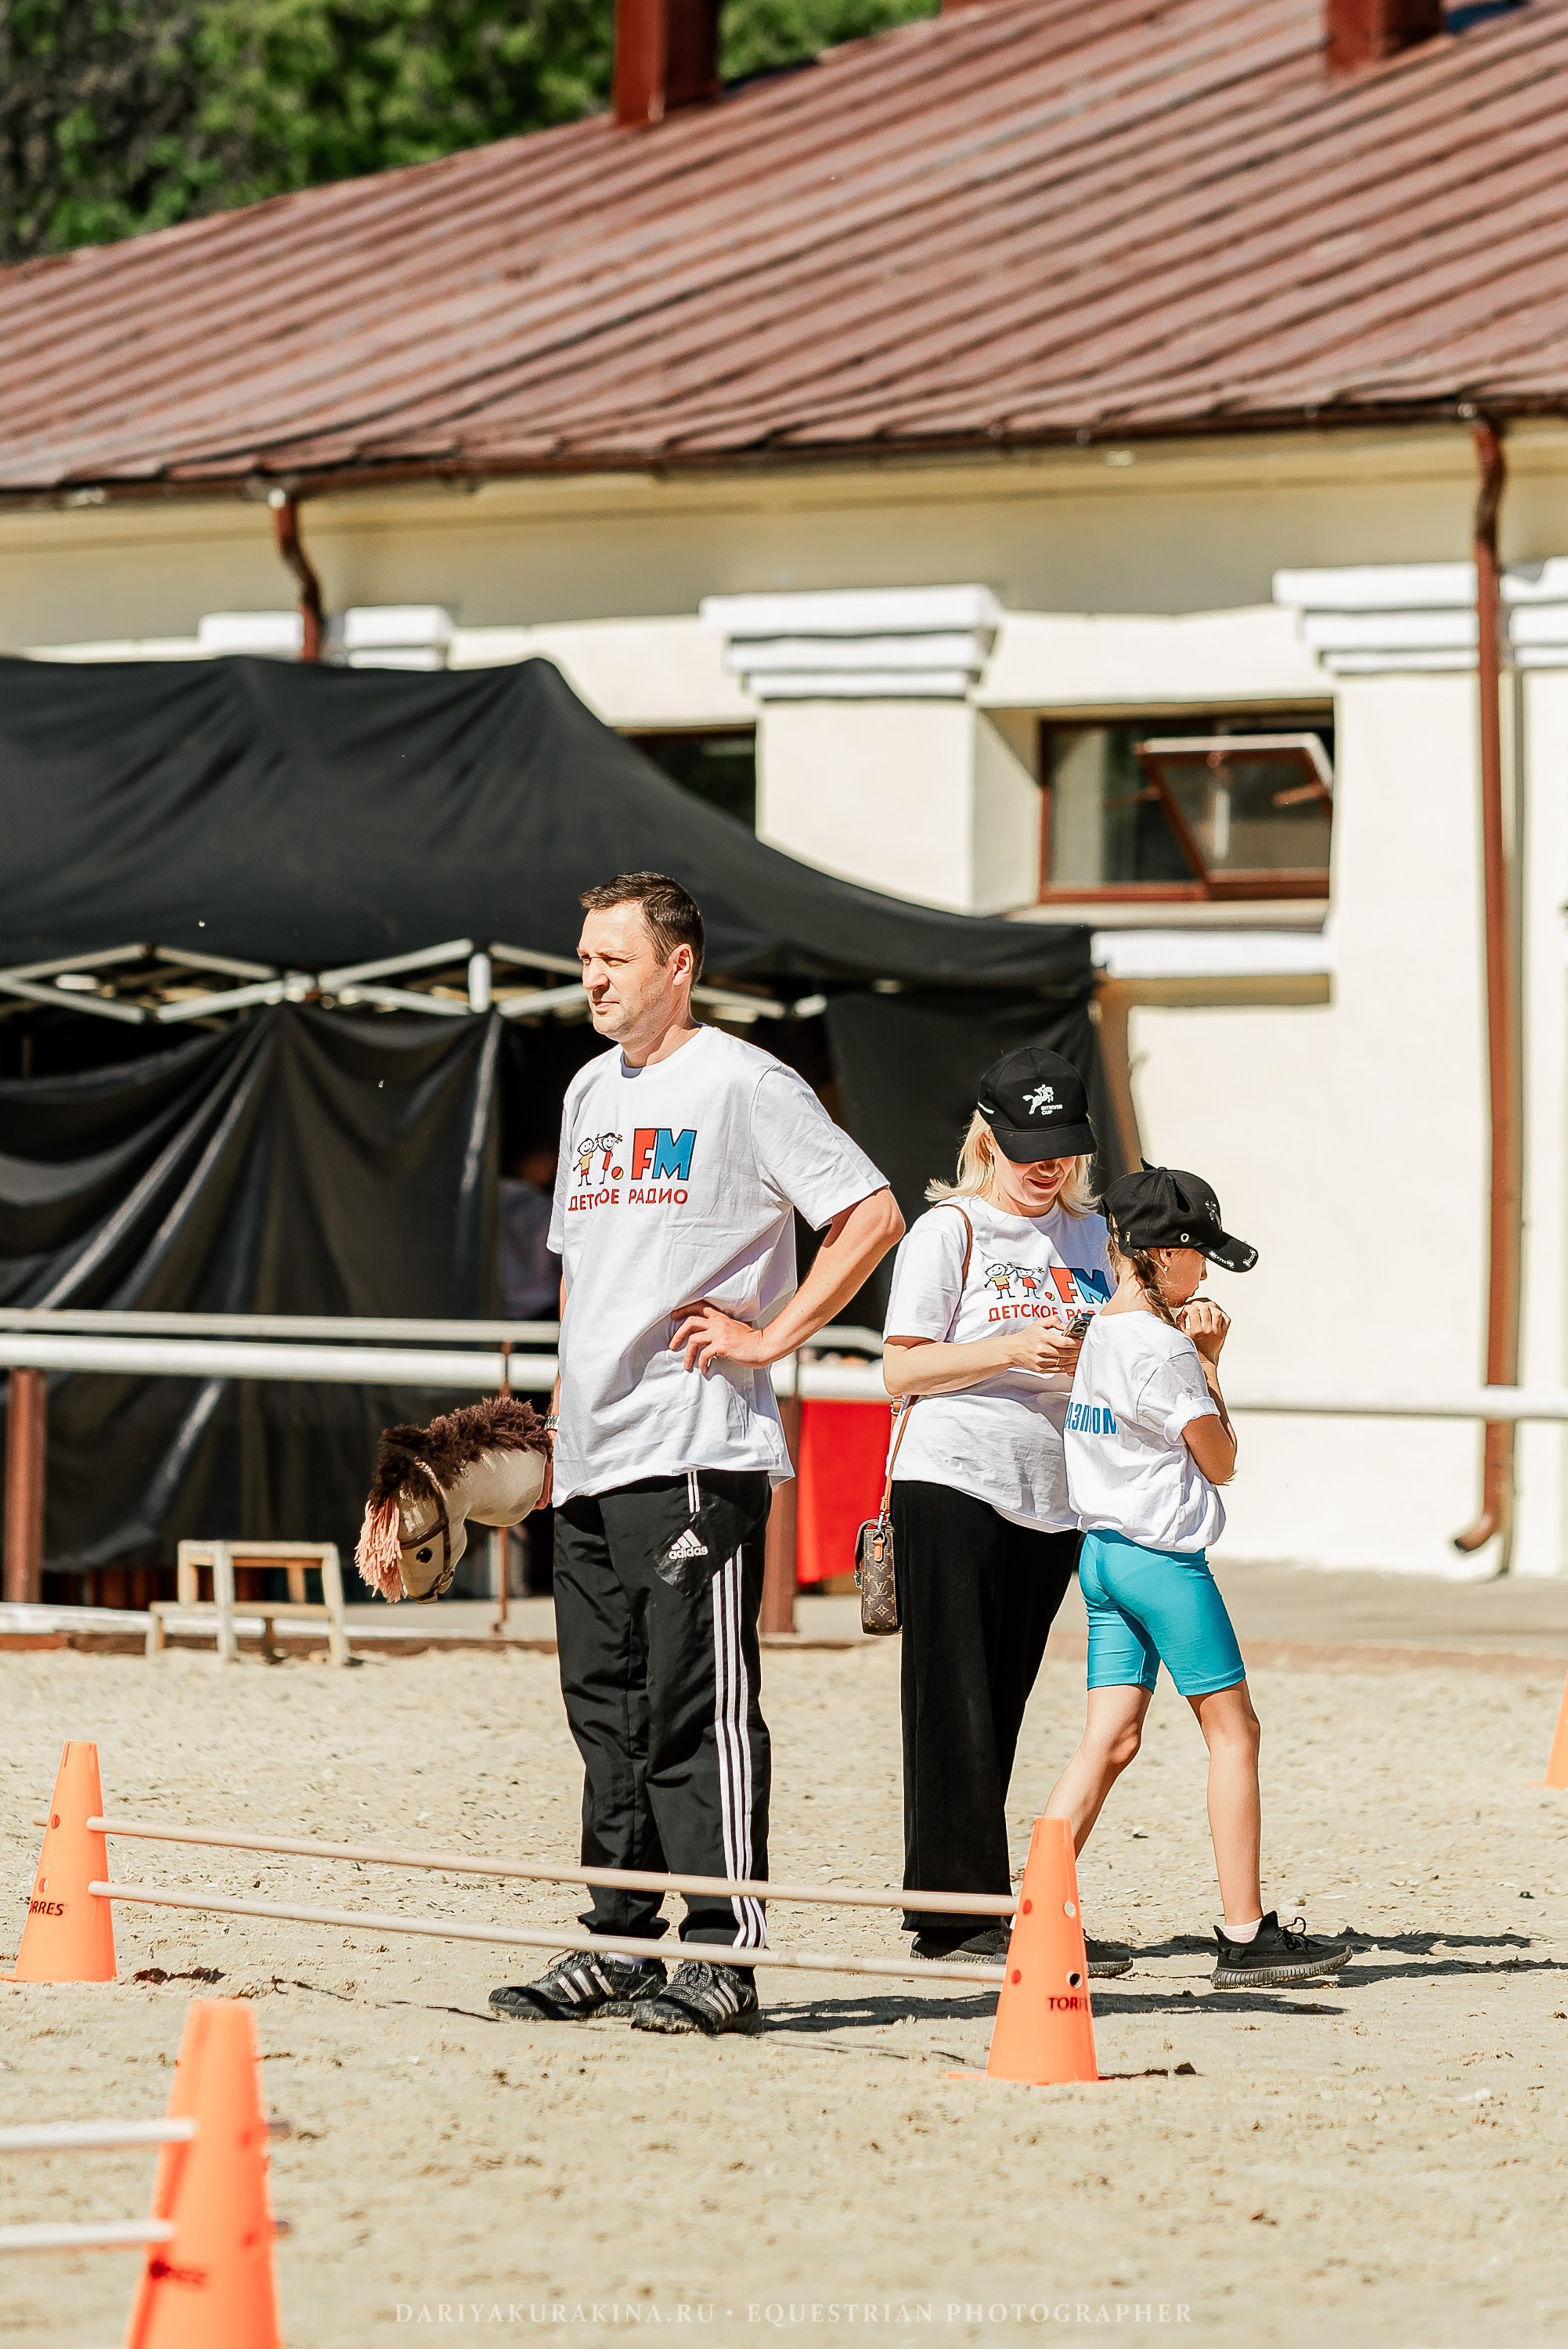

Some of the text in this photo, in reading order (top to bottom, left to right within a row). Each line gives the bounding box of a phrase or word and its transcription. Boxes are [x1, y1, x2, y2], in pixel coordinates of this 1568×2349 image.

[631, 1128, 697, 1181] FM
[628, 1188, 689, 1205] РАДИО
[668, 1546, 708, 1560] adidas
[29, 1900, 65, 1916] RRES
